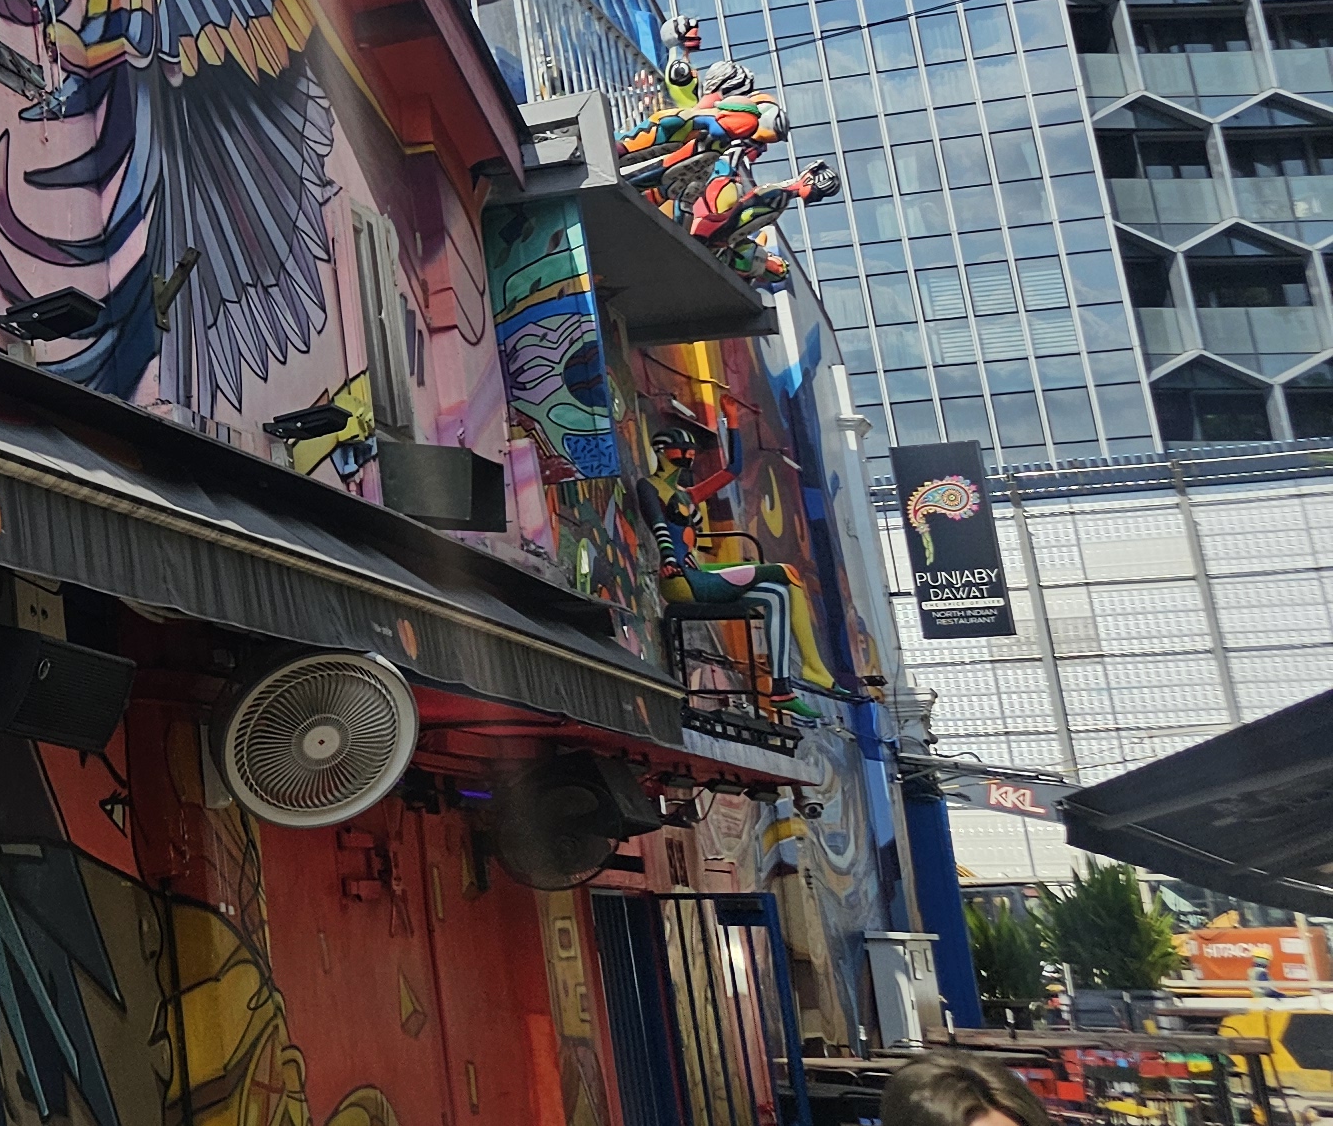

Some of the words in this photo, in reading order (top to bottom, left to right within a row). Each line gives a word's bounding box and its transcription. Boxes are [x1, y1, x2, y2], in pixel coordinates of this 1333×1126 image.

[916, 568, 999, 587] PUNJABY
[930, 585, 990, 600] DAWAT
[932, 609, 965, 618] NORTH
[966, 608, 998, 617] INDIAN
[936, 616, 996, 625] RESTAURANT
